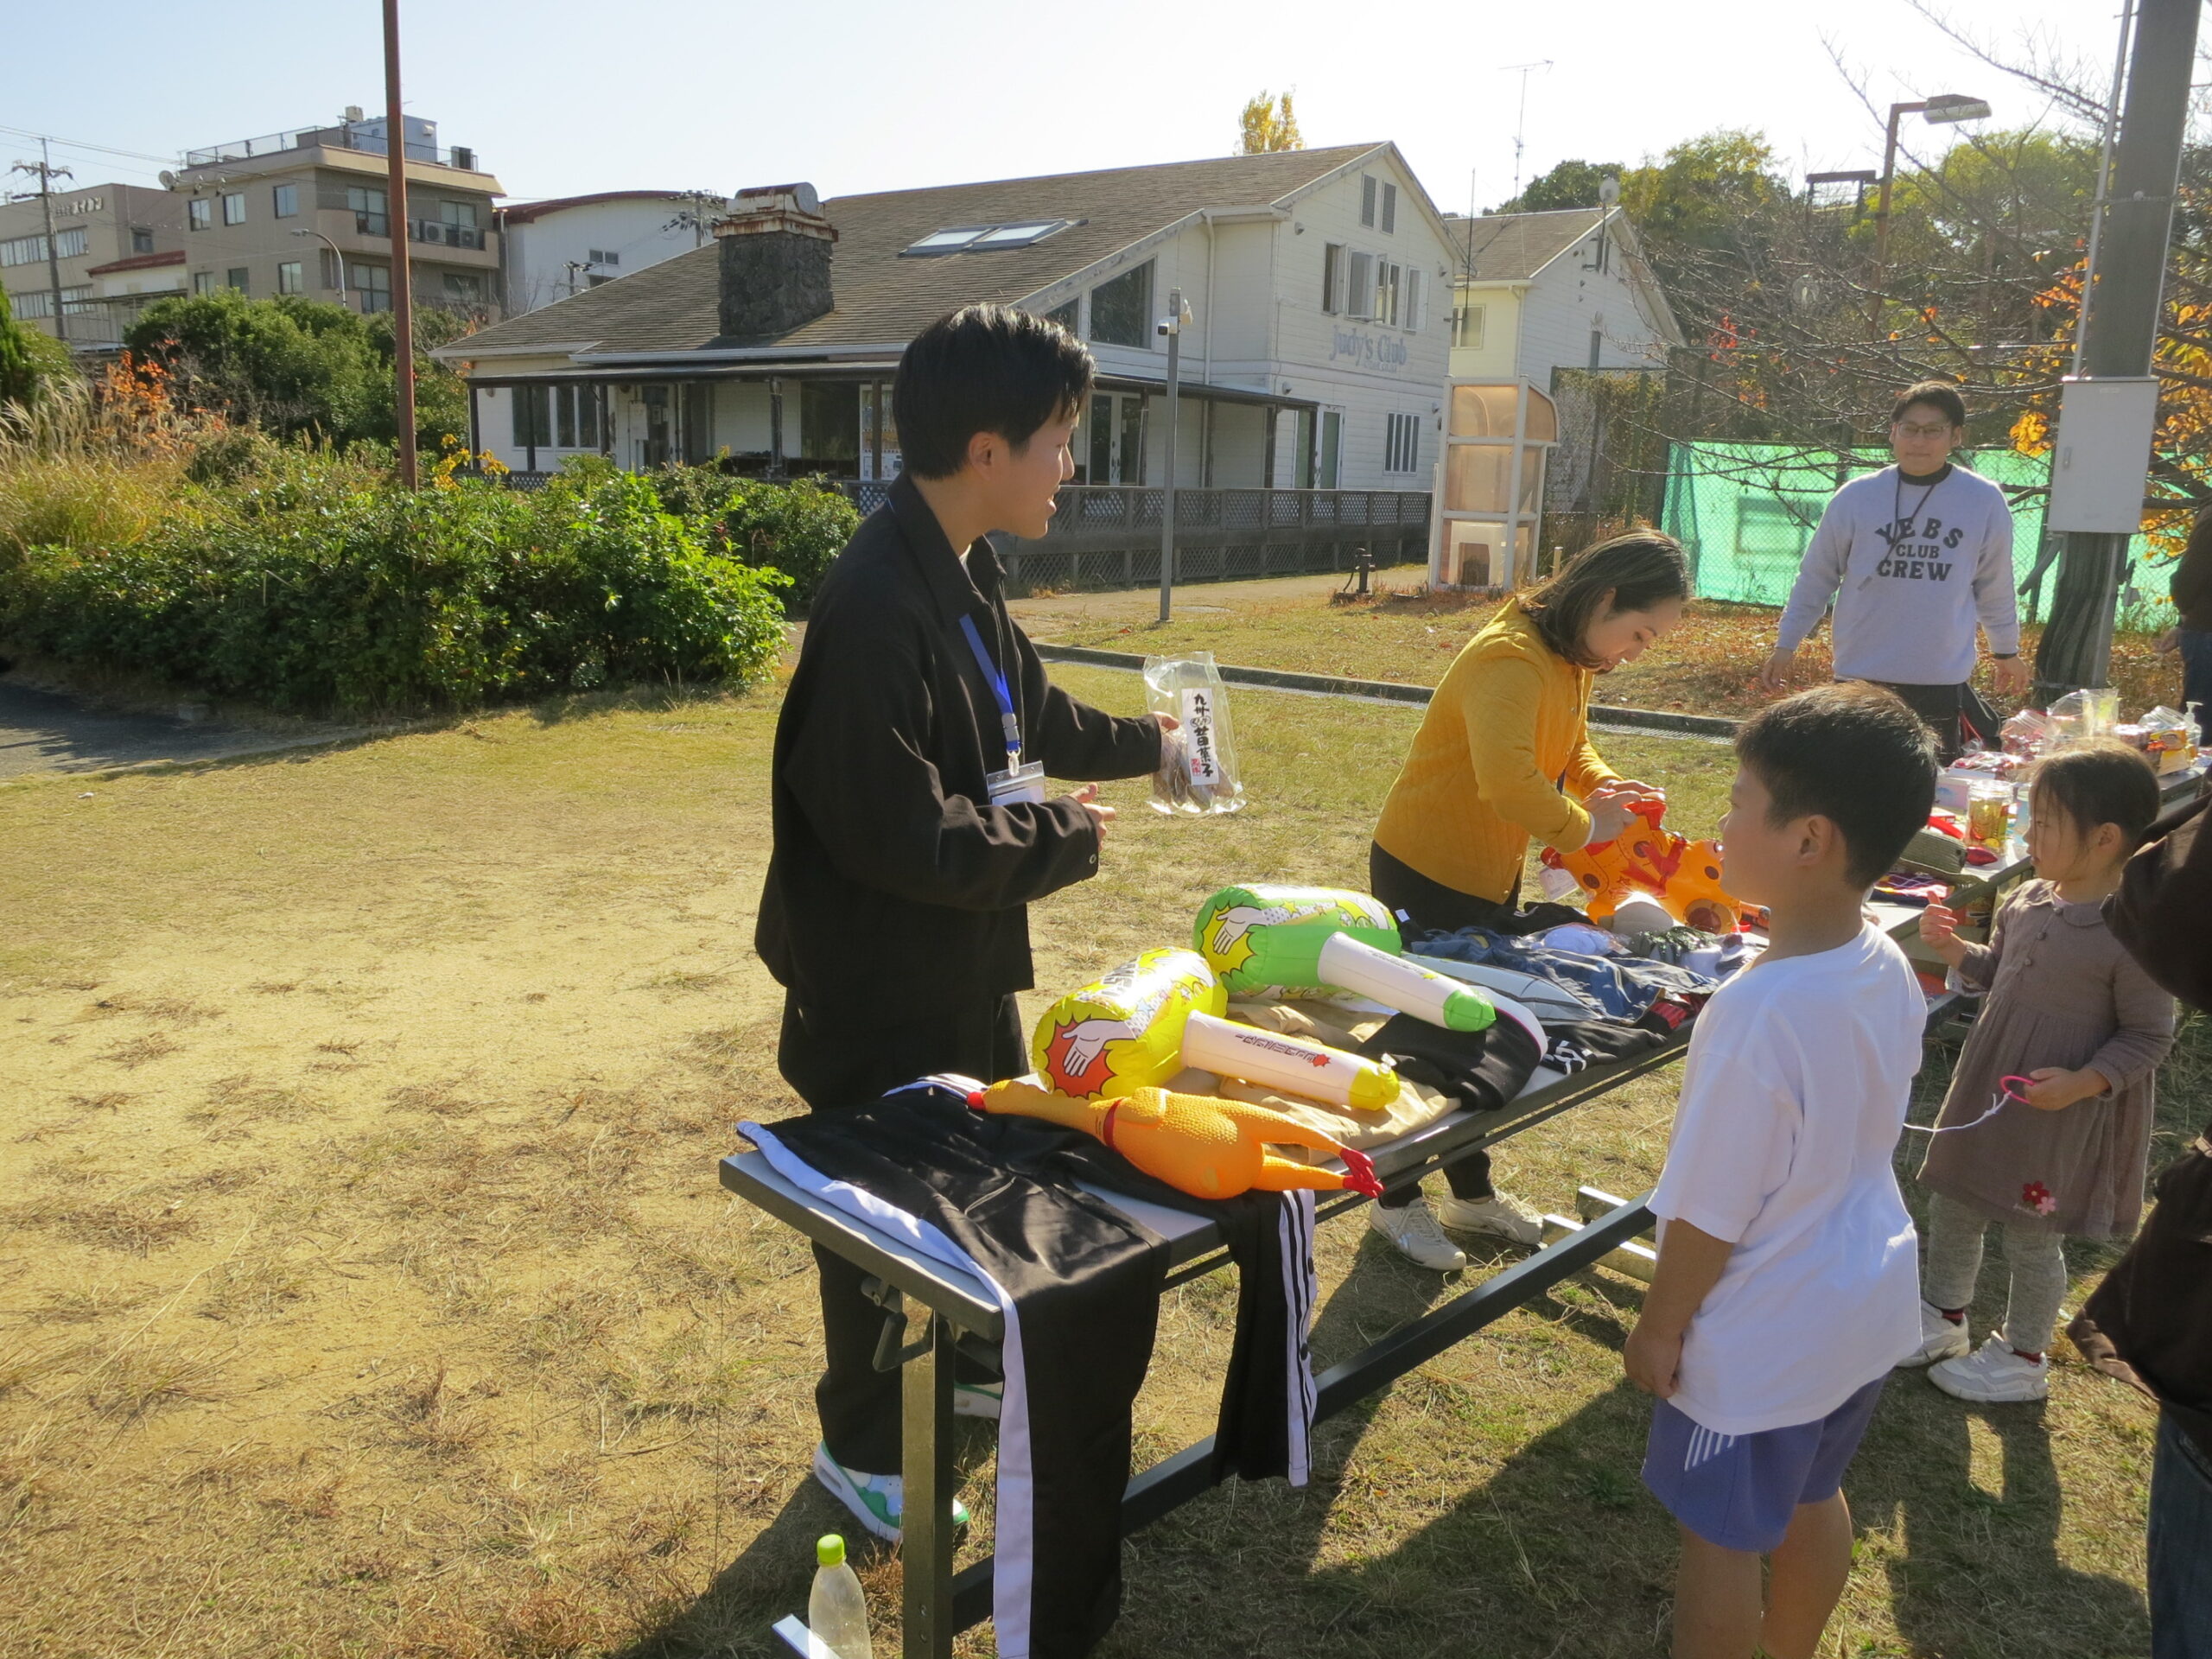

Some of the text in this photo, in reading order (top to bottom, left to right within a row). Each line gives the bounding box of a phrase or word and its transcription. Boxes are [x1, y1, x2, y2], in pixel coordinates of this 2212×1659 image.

[1329, 324, 1408, 367] Judy's Club
[1874, 517, 1964, 549] YEBS
[1896, 544, 1940, 559] CLUB
[1876, 559, 1953, 582] CREW
